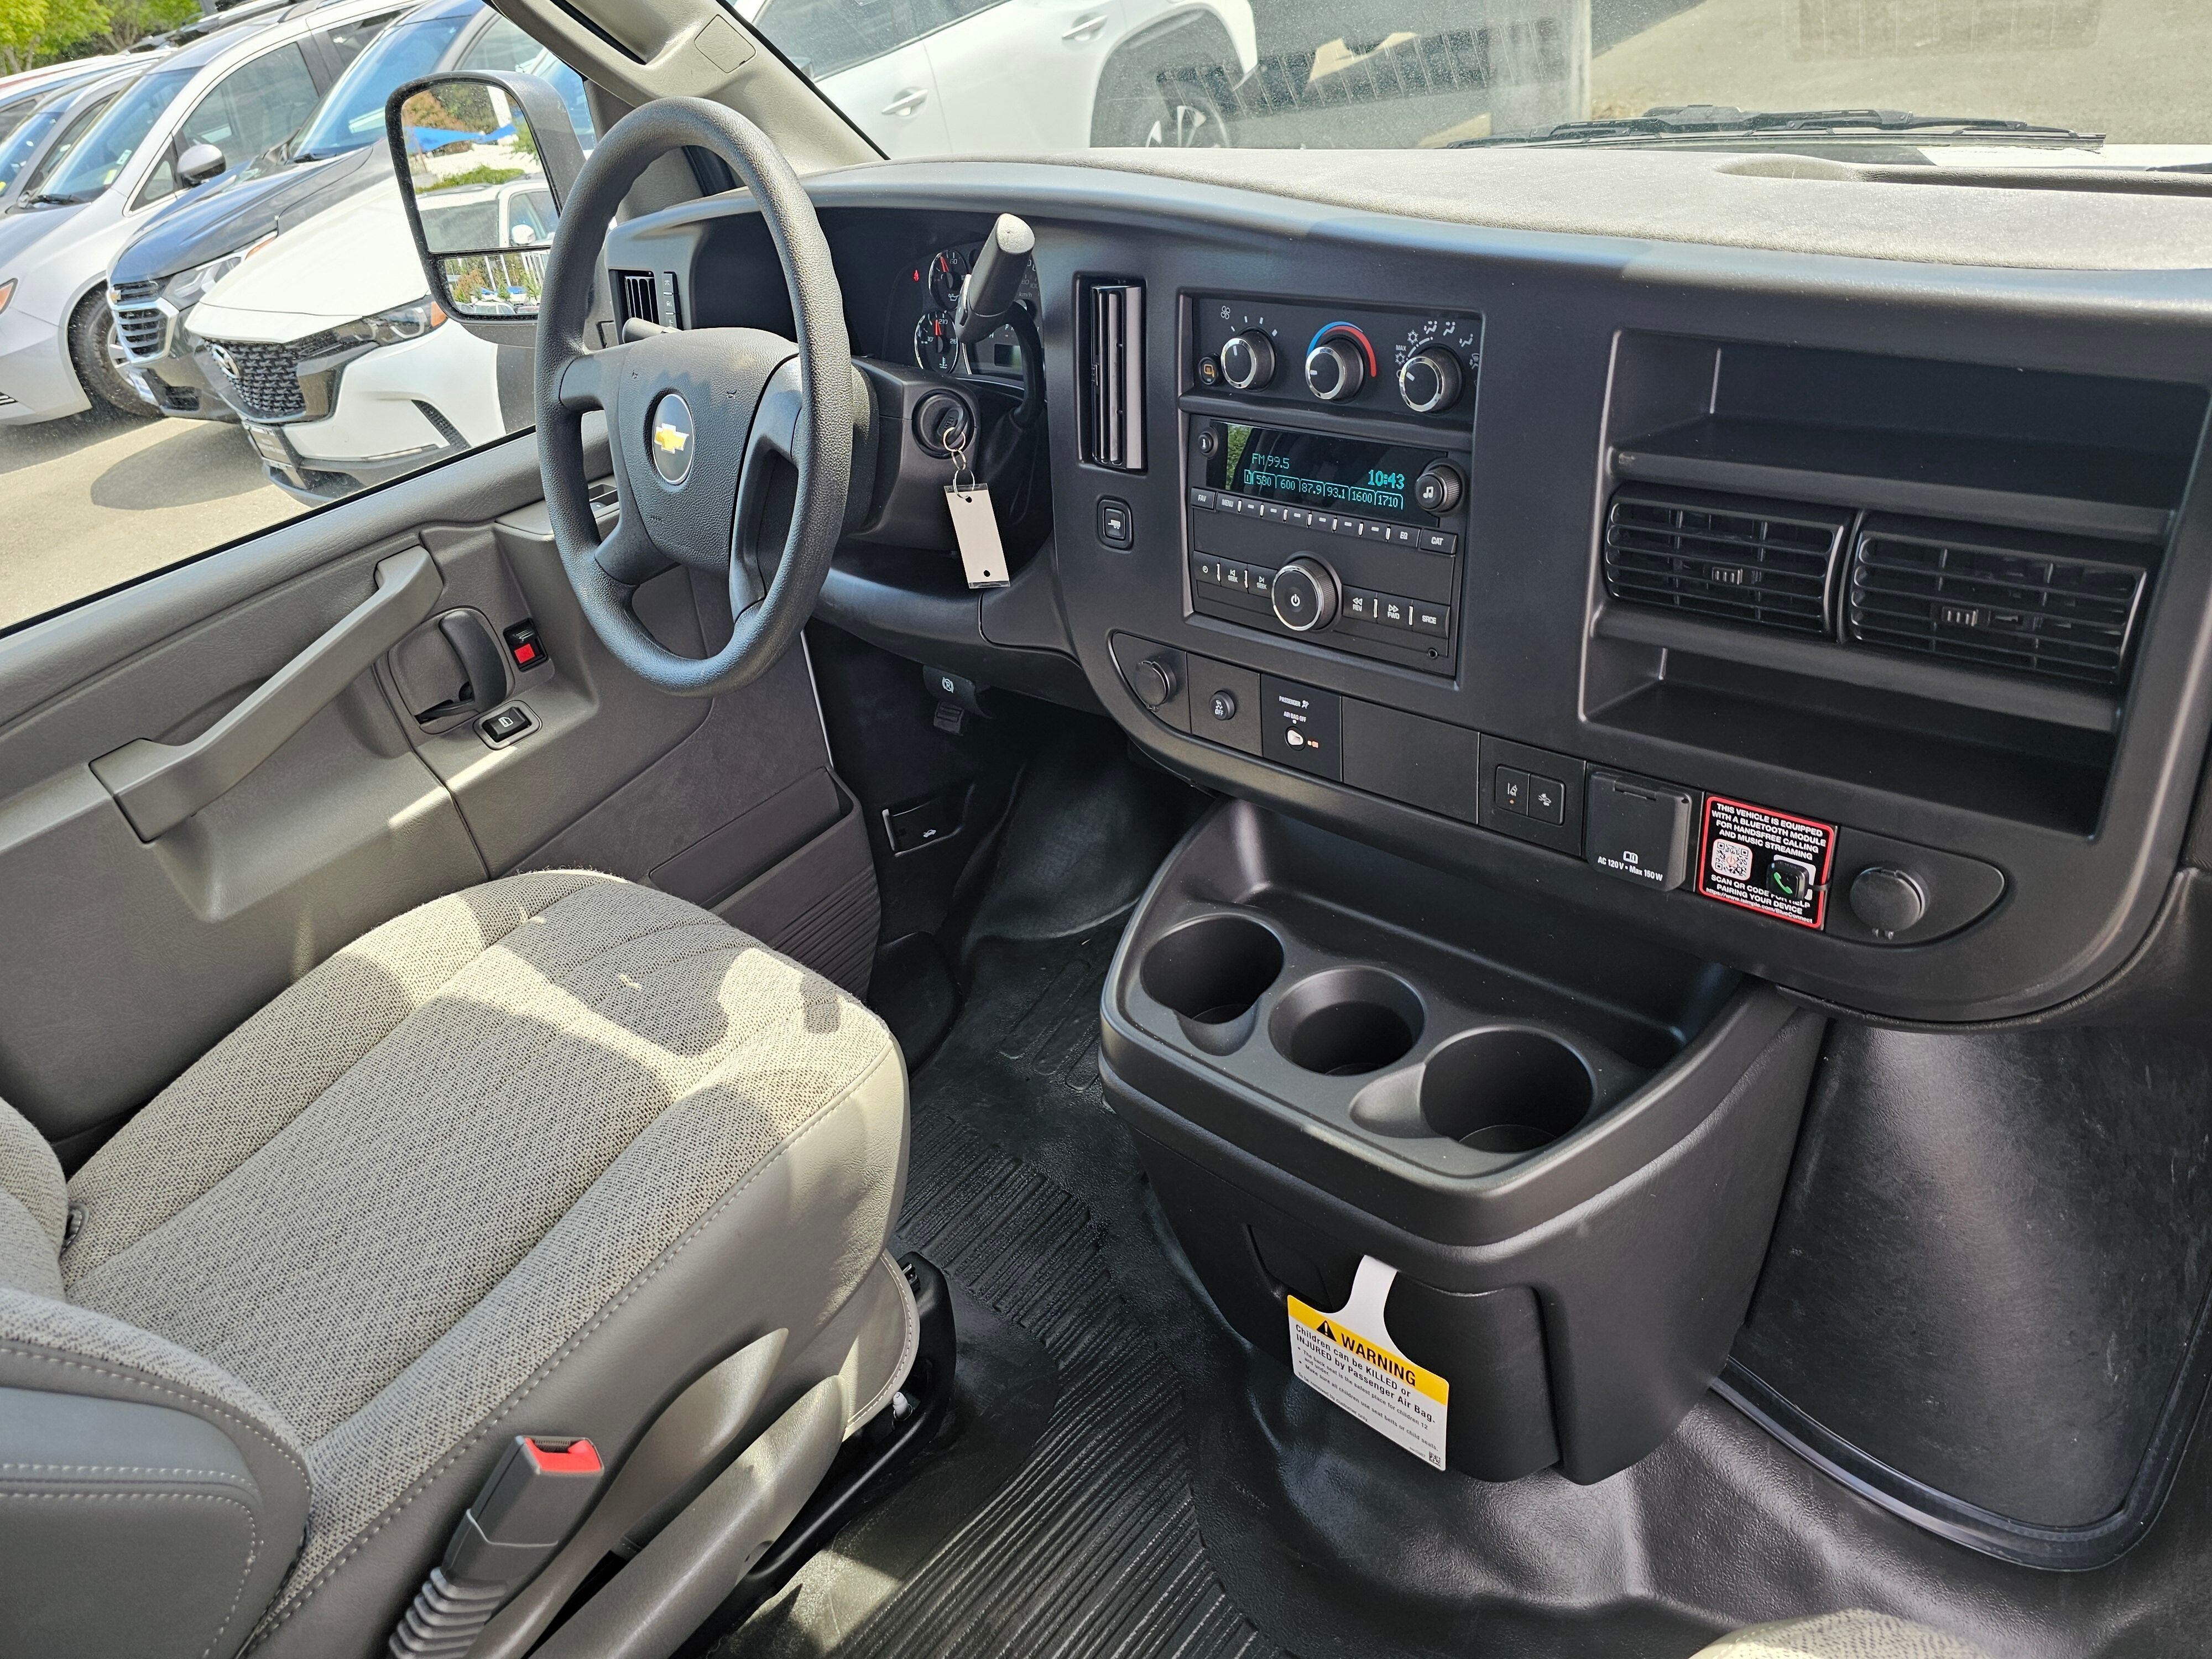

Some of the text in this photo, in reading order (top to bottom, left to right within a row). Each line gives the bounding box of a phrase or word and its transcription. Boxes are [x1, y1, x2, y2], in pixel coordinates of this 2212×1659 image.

[1252, 453, 1290, 469] FM 99.5
[1256, 474, 1272, 487] 580
[1280, 479, 1295, 491] 600
[1302, 482, 1322, 495] 87.9
[1327, 487, 1345, 499] 93.1
[1352, 491, 1373, 504] 1600
[1378, 494, 1399, 508] 1710
[1368, 469, 1405, 490] 10:43
[1221, 499, 1234, 508] MENU
[1431, 536, 1444, 546] CAT
[1353, 603, 1363, 612] REV
[1387, 611, 1400, 620] FWD
[1422, 614, 1437, 624] SRCE
[1712, 810, 1827, 847] WITH A BLUETOOTH MODULE
[1717, 803, 1823, 837] THIS VEHICLE IS EQUIPPED
[1716, 819, 1819, 854] FOR HANDSFREE CALLING
[1719, 829, 1813, 861] AND MUSIC STREAMING
[1597, 855, 1607, 865] AC
[1629, 865, 1643, 876] Max
[1710, 874, 1733, 886] SCAN
[1733, 881, 1746, 890] QR
[1747, 885, 1770, 897] CODE
[1717, 883, 1803, 915] PAIRING YOUR DEVICE
[1296, 1324, 1411, 1397] Children can be KILLED or
[1341, 1332, 1416, 1387] WARNING
[1296, 1333, 1436, 1423] INJURED by Passenger Air Bag.
[1303, 1349, 1312, 1359] The
[1313, 1356, 1326, 1368] back
[1327, 1365, 1337, 1376] seat
[1344, 1376, 1353, 1385] the
[1354, 1383, 1370, 1396] safest
[1371, 1392, 1386, 1405] place
[1387, 1402, 1396, 1411] for
[1396, 1408, 1420, 1425] children
[1305, 1364, 1319, 1376] Make
[1339, 1387, 1360, 1404] children
[1361, 1401, 1370, 1410] use
[1371, 1407, 1383, 1418] seat
[1384, 1415, 1398, 1427] belts
[1406, 1428, 1421, 1441] child
